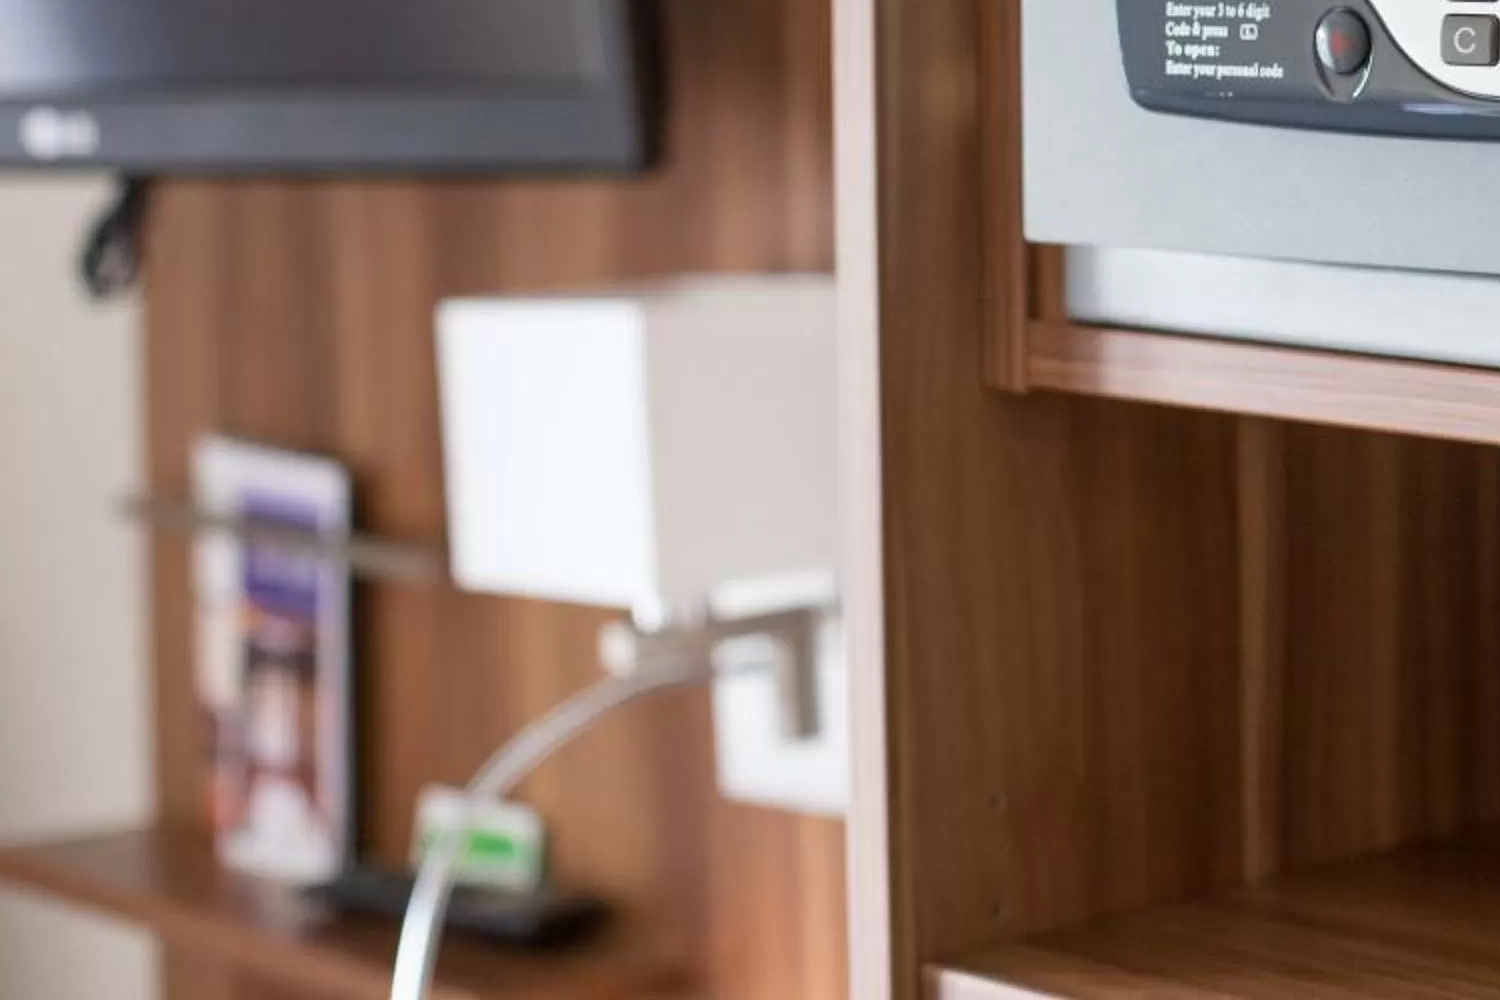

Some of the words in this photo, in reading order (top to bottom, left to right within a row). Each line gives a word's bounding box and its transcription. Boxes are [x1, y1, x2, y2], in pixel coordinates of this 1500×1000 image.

[1165, 2, 1191, 18] Enter
[1192, 4, 1216, 20] your
[1217, 2, 1224, 17] 3
[1225, 3, 1237, 18] to
[1237, 2, 1245, 18] 6
[1246, 1, 1271, 21] digit
[1165, 21, 1191, 37] Code
[1202, 24, 1229, 41] press
[1453, 27, 1476, 53] C
[1165, 39, 1182, 56] To
[1184, 42, 1221, 60] open:
[1165, 59, 1192, 76] Enter
[1193, 63, 1216, 80] your
[1216, 62, 1259, 80] personal
[1259, 62, 1285, 79] code
